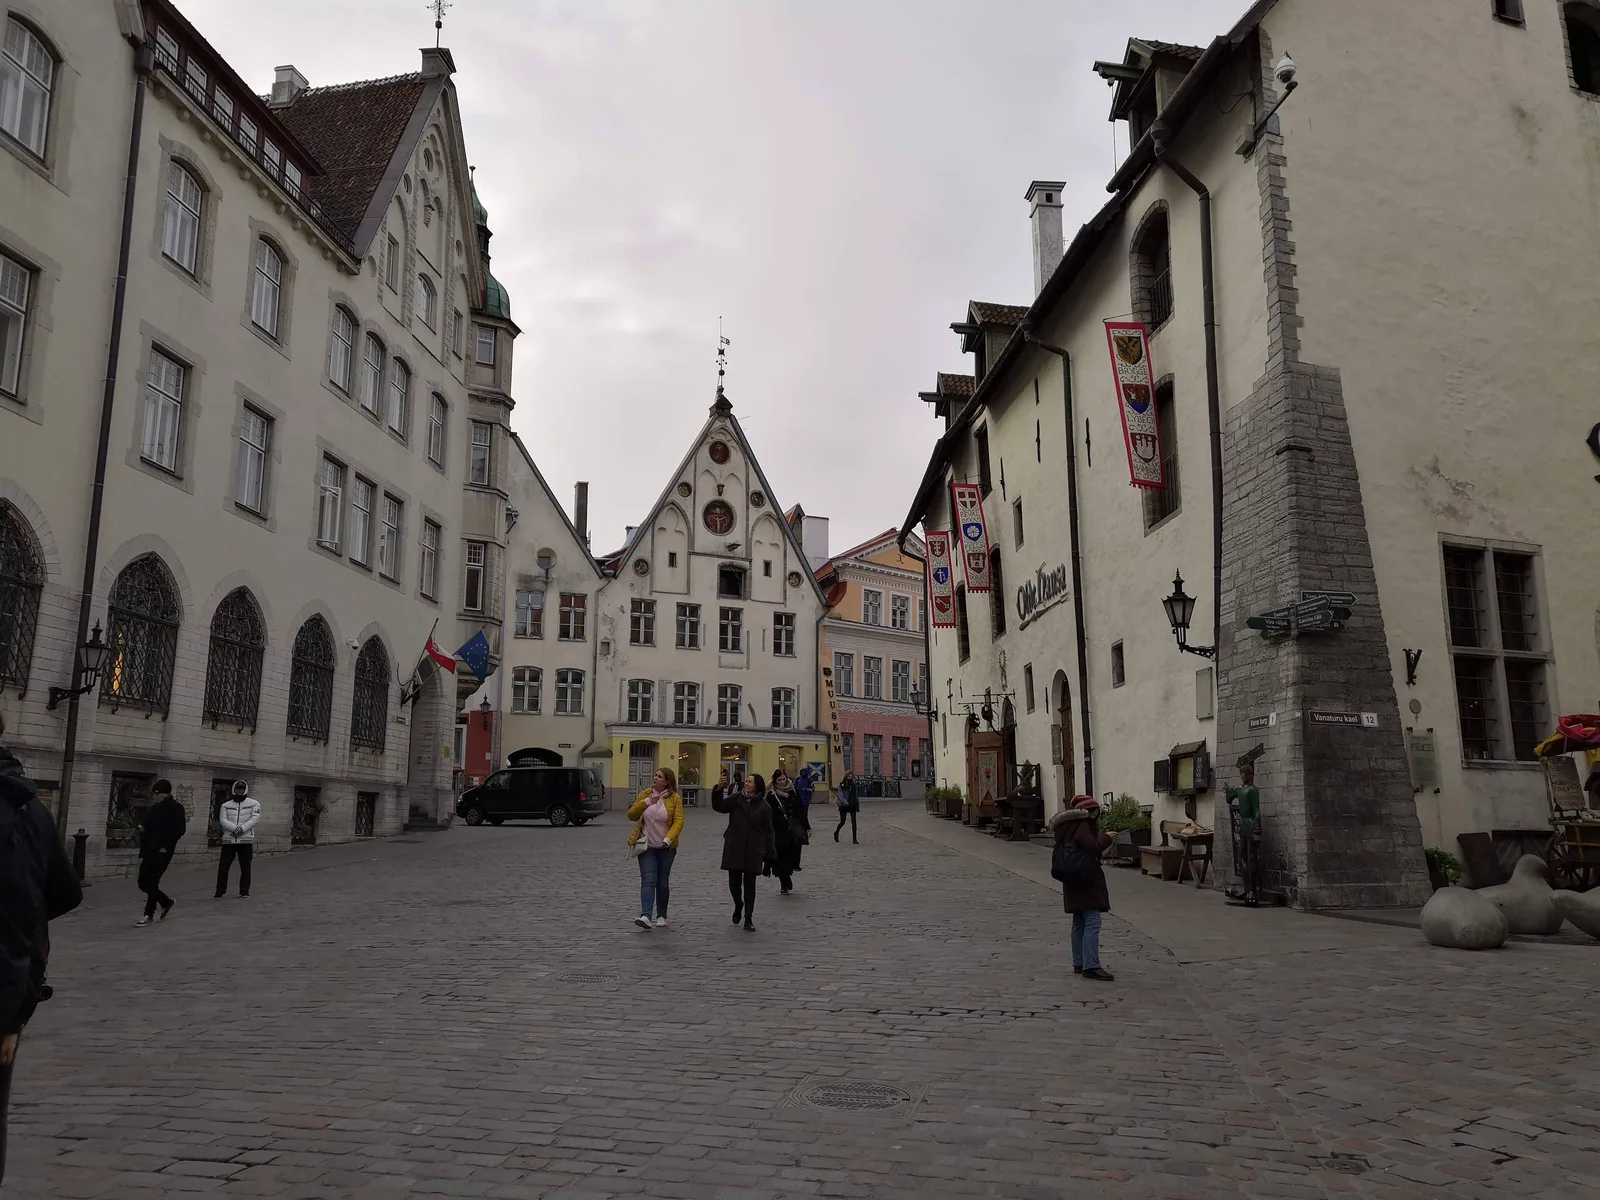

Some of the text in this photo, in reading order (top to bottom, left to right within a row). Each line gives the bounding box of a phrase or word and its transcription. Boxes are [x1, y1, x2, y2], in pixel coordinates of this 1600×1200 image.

[1118, 366, 1149, 376] BRYGGE
[825, 679, 842, 753] MUUSEUM
[1313, 713, 1375, 725] Vanaturu kael 12
[1250, 719, 1260, 727] Vana
